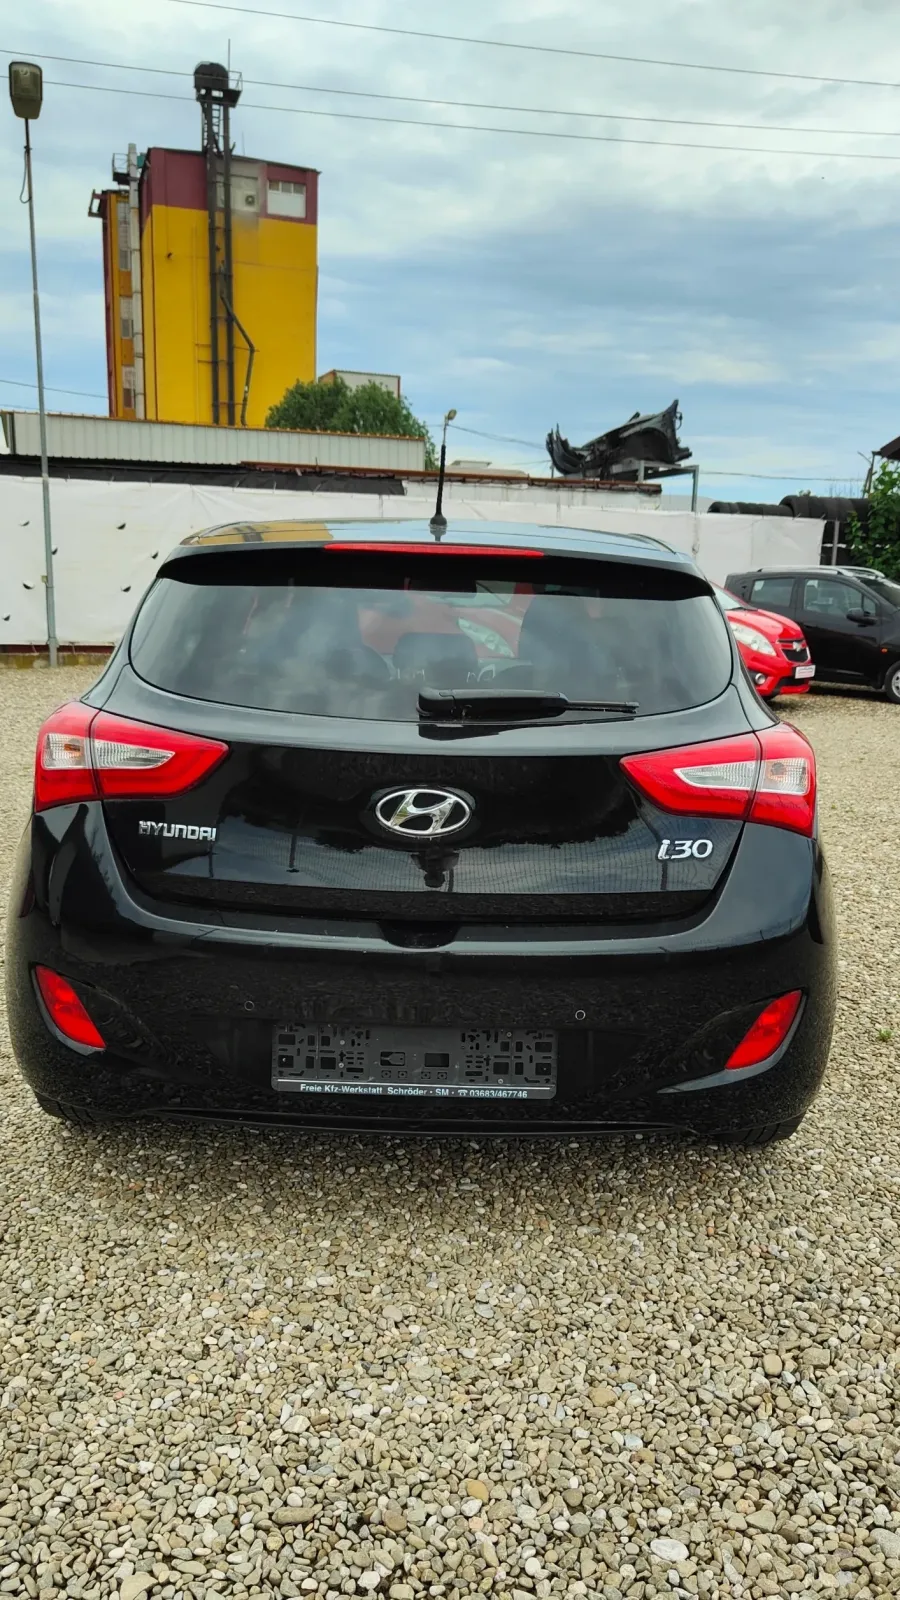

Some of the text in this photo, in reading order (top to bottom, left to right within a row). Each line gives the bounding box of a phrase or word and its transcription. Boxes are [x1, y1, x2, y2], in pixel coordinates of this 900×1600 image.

[138, 820, 217, 841] HYUNDAI
[657, 839, 713, 860] i30
[300, 1083, 528, 1099] Freie Kfz-Werkstatt Schröder SM 03683/467746
